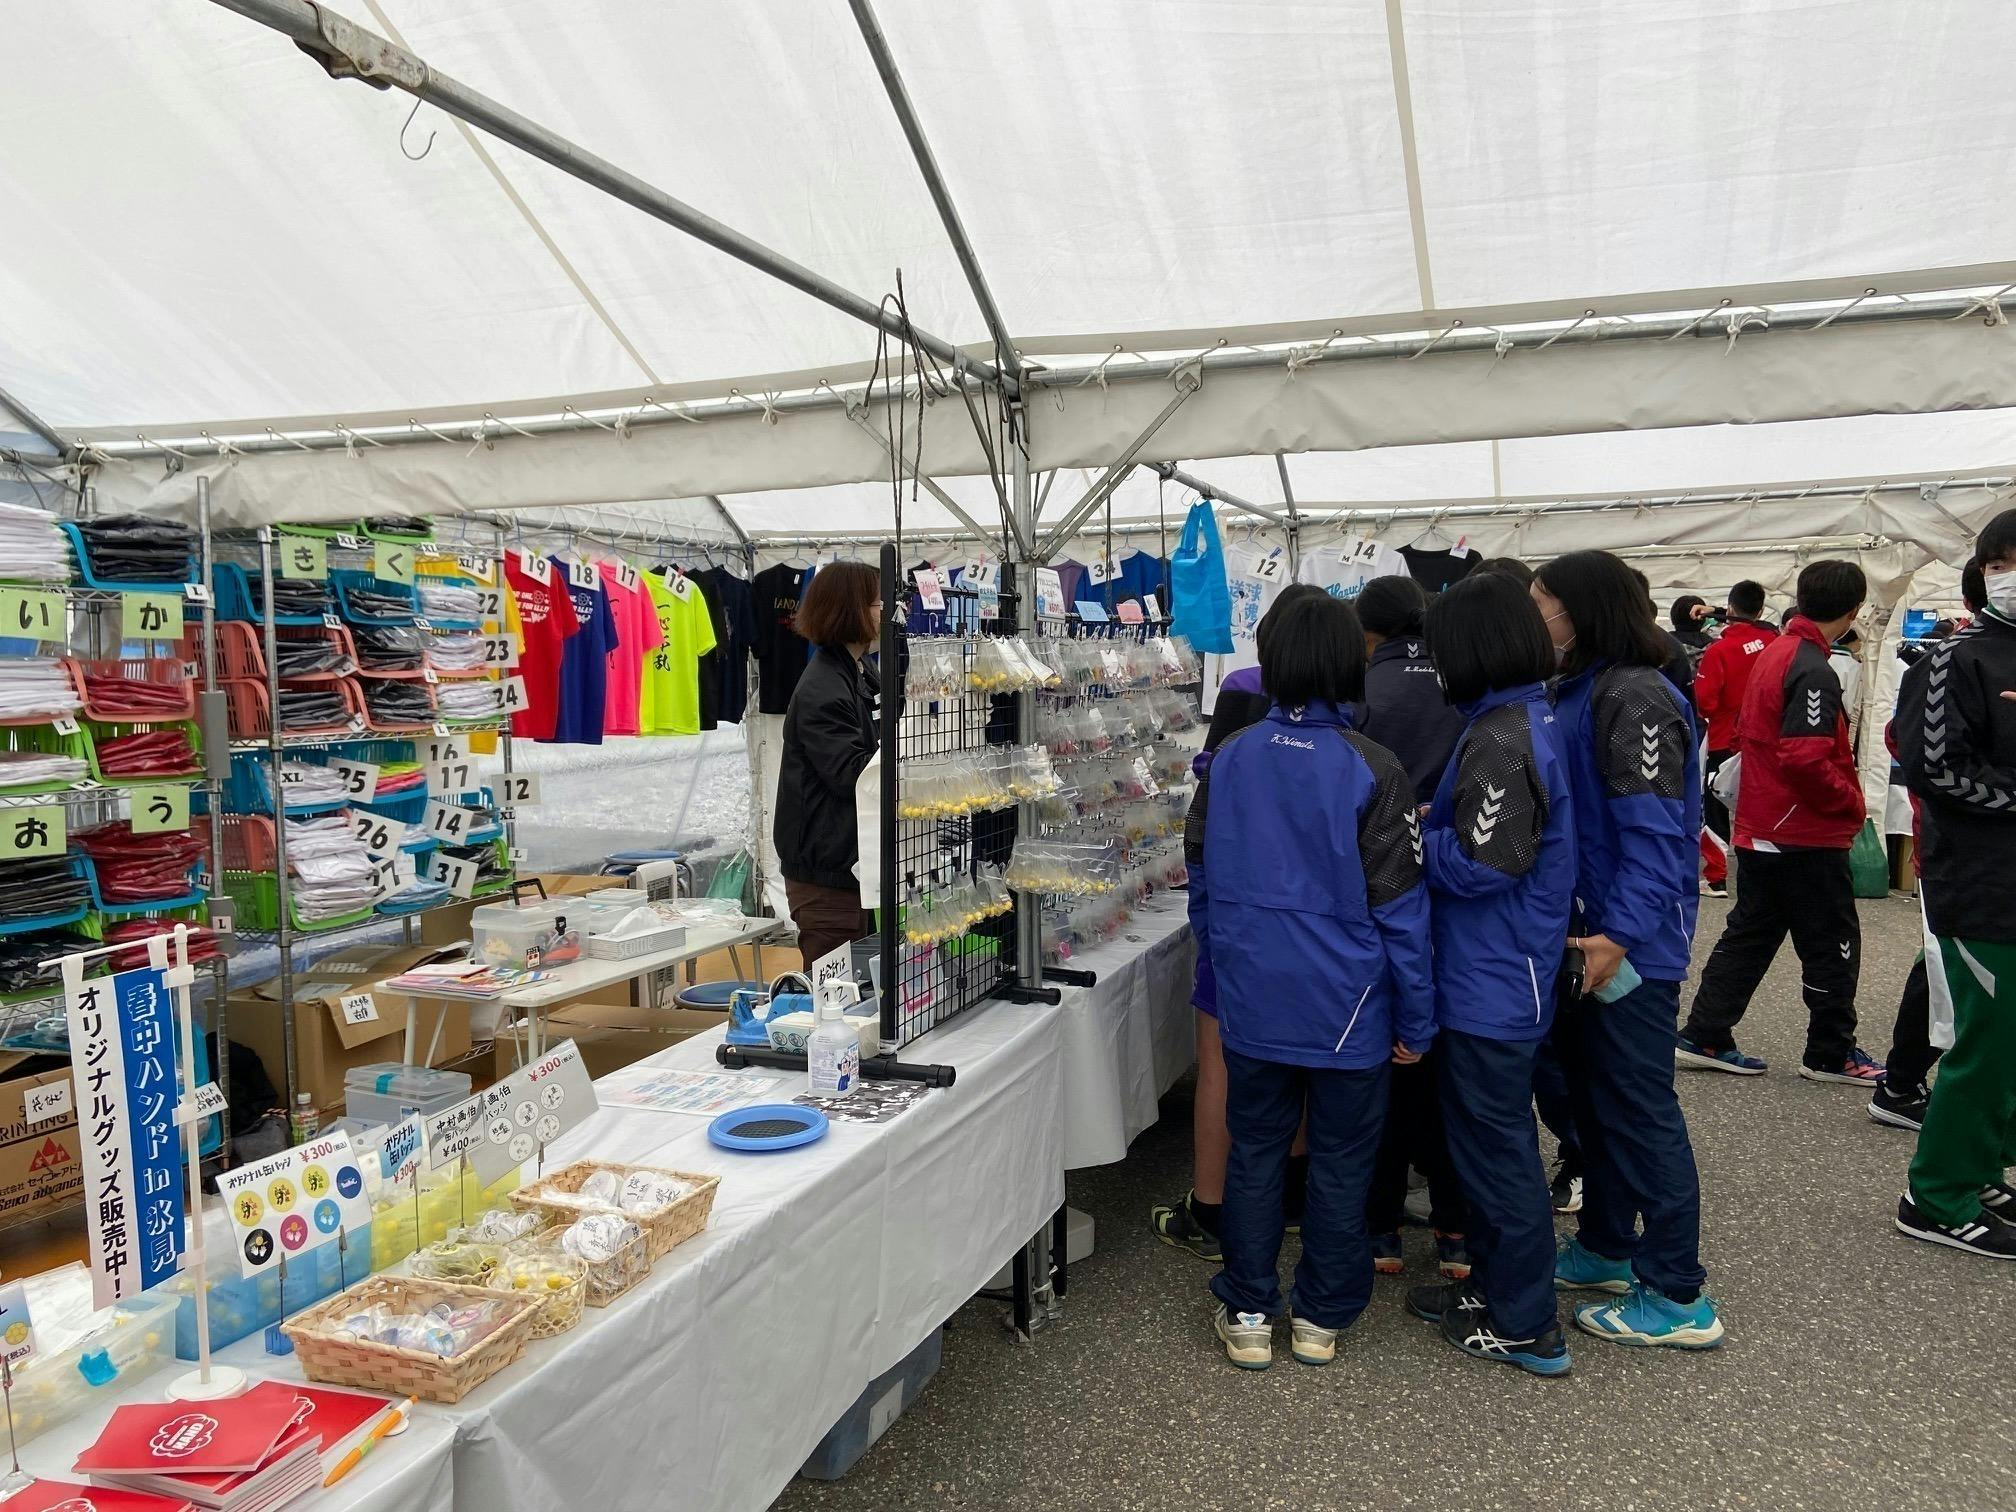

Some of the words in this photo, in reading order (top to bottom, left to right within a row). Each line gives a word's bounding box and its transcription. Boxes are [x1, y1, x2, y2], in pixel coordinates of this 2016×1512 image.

[294, 546, 315, 573] き
[1352, 540, 1376, 560] 14
[387, 552, 403, 577] く
[529, 555, 547, 575] 19
[576, 566, 594, 585] 18
[621, 565, 636, 586] 17
[968, 564, 988, 581] 31
[1255, 558, 1278, 576] 12
[192, 586, 203, 596] L
[668, 574, 685, 594] 16
[20, 599, 50, 630] い
[139, 602, 169, 631] か
[326, 616, 340, 626] XL
[485, 640, 509, 662] 23
[184, 665, 194, 677] M
[493, 684, 518, 708] 24
[281, 772, 303, 783] XL
[337, 767, 367, 793] 25
[441, 764, 469, 789] 17
[504, 778, 530, 801] 12
[148, 796, 173, 824] う
[500, 811, 516, 820] XL
[14, 817, 49, 849] お
[355, 818, 389, 850] 26
[434, 809, 462, 836] 14
[513, 849, 522, 859] L
[434, 862, 463, 888] 31
[218, 918, 227, 930] L
[527, 1056, 562, 1083] ¥300
[483, 1085, 512, 1111] 画伯
[436, 1104, 477, 1132] 中村画伯
[298, 1140, 334, 1164] ¥300
[442, 1136, 470, 1158] ¥400
